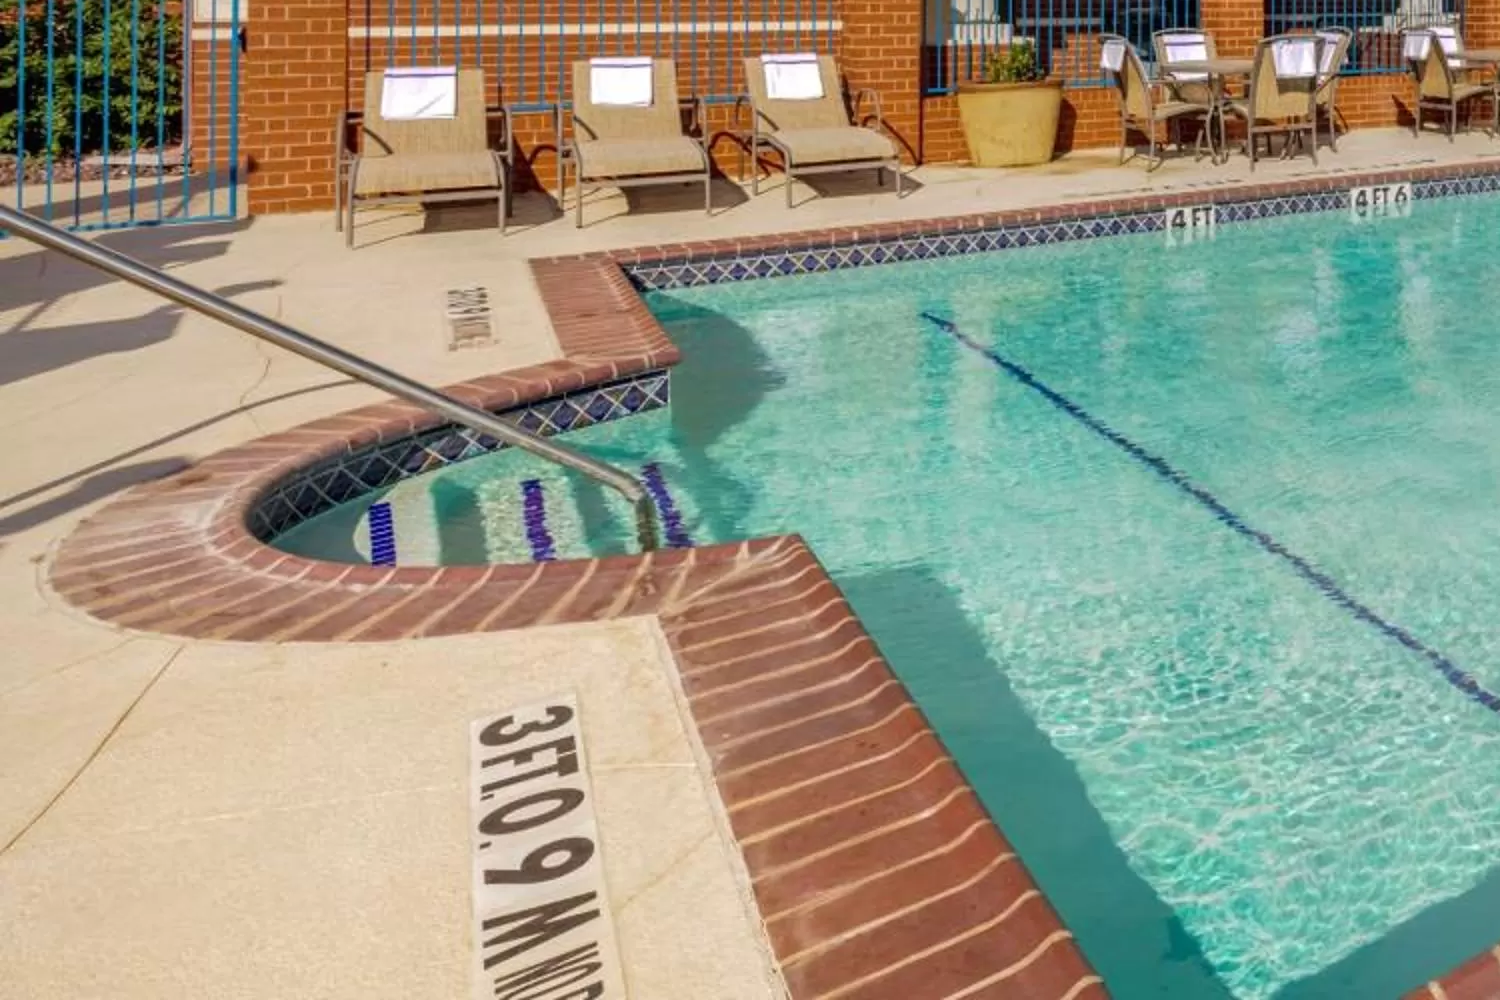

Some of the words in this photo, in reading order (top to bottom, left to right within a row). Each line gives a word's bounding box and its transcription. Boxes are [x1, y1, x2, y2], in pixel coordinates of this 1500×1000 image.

[1354, 189, 1368, 207] 4
[1373, 187, 1390, 204] FT
[1395, 185, 1407, 202] 6
[1171, 209, 1186, 228] 4
[1191, 207, 1212, 227] FT
[479, 705, 574, 747] 3
[482, 891, 600, 970] M
